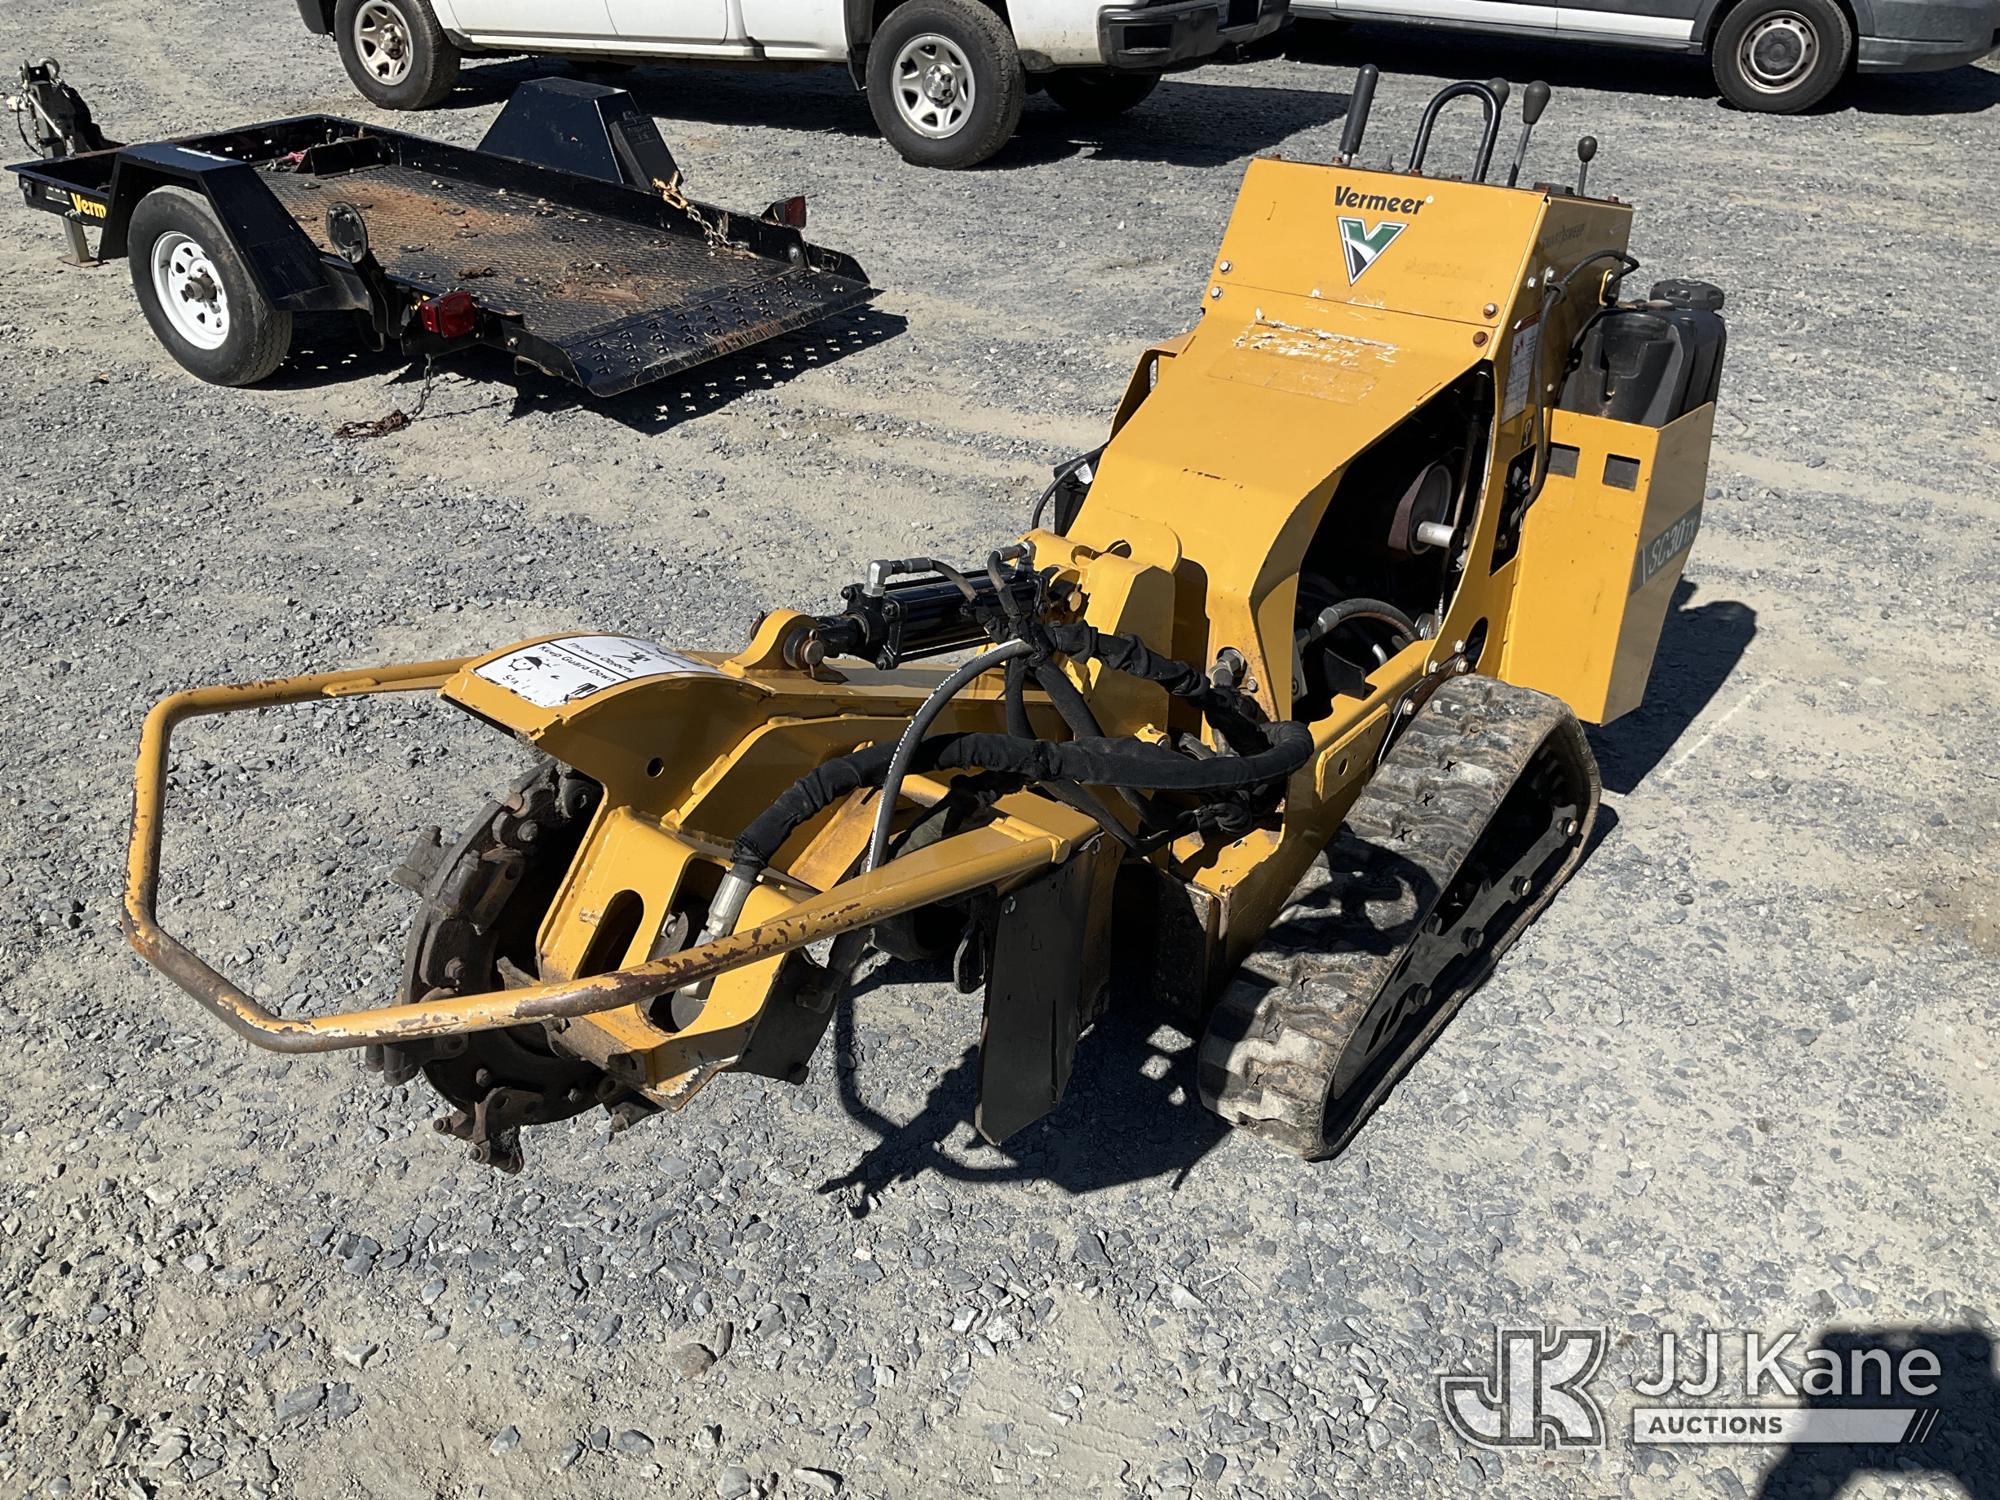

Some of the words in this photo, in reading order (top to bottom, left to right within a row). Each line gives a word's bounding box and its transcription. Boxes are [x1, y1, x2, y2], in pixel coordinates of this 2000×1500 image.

[1334, 185, 1425, 215] Vermeer
[538, 646, 562, 658] Keep
[561, 656, 590, 670] Guard
[588, 668, 617, 683] Down
